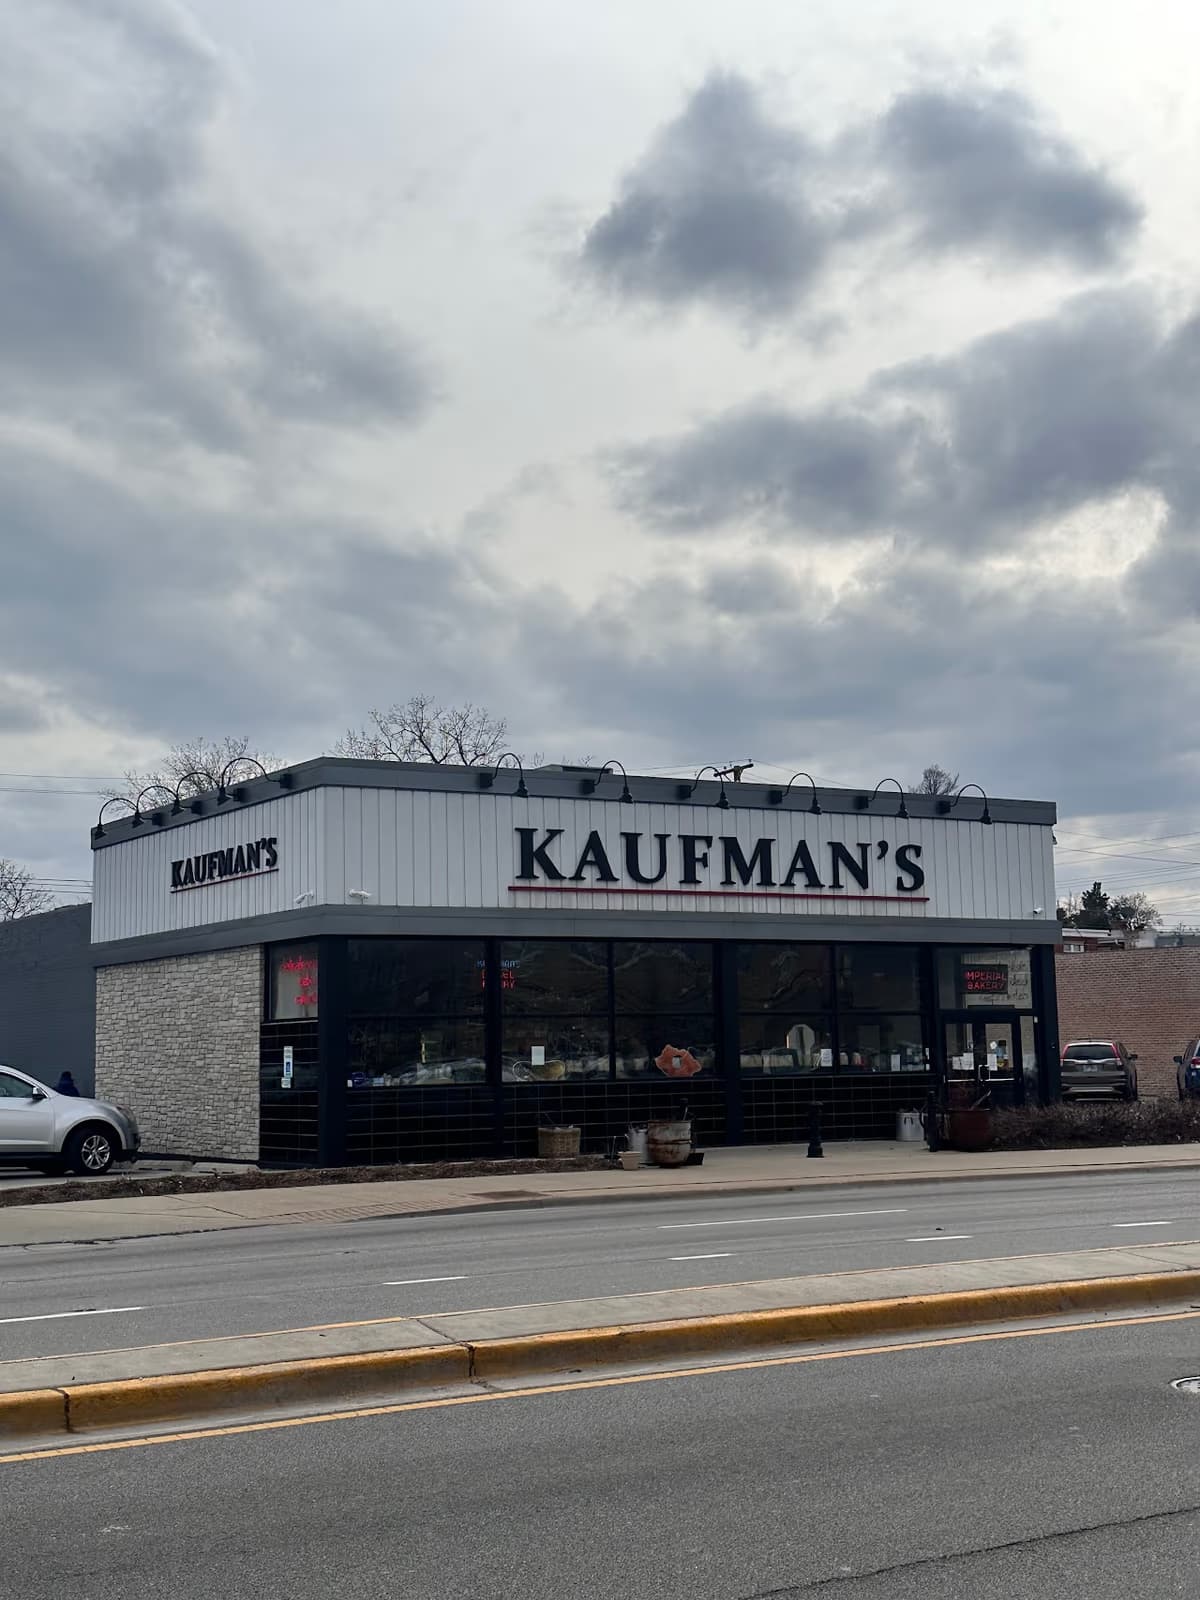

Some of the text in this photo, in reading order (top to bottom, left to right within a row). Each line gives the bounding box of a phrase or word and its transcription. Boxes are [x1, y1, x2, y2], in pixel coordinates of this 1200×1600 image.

[170, 837, 278, 889] KAUFMAN'S
[514, 826, 926, 892] KAUFMAN'S
[967, 981, 1005, 990] BAKERY
